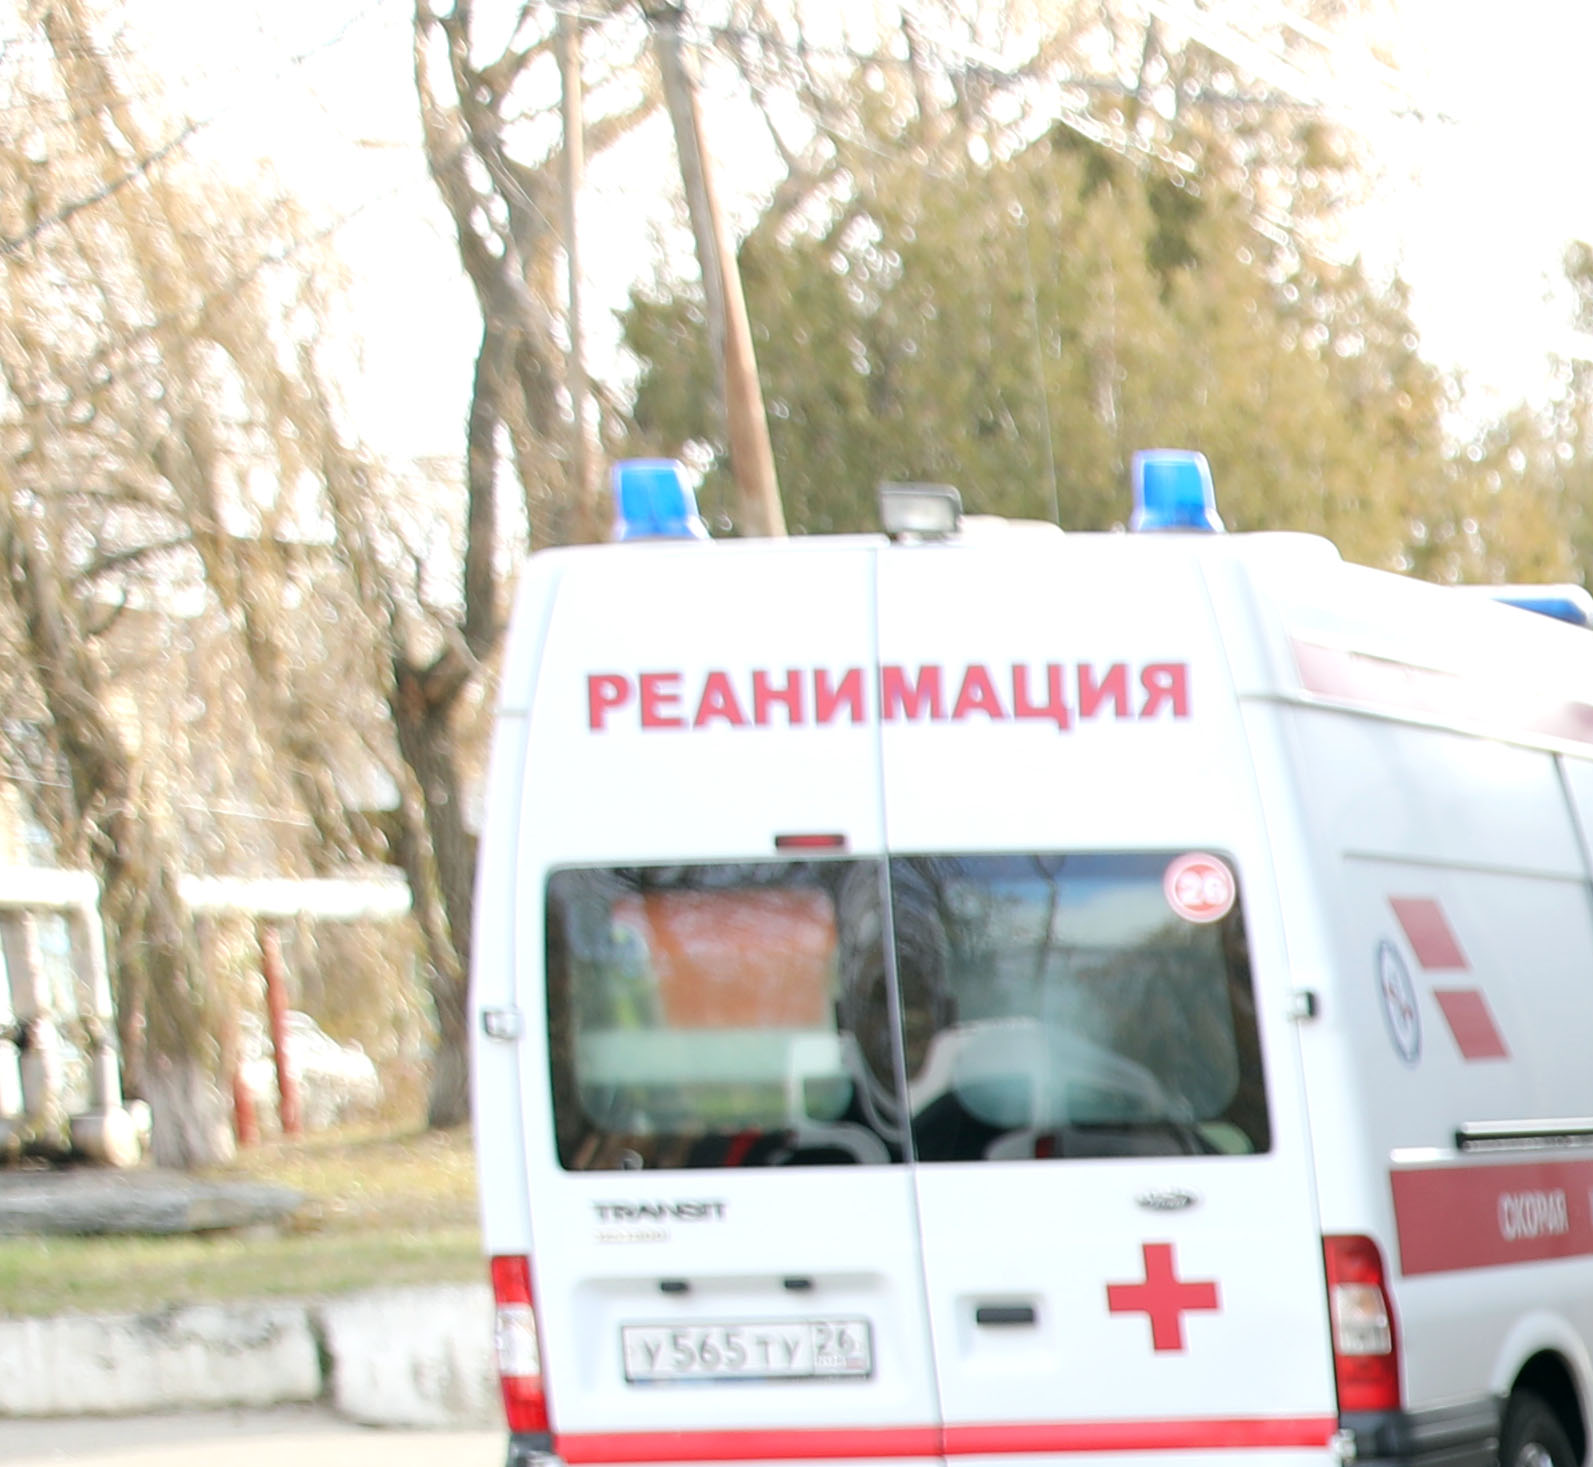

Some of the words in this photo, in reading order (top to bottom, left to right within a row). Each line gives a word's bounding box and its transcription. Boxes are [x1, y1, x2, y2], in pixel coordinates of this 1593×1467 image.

[586, 662, 1190, 731] РЕАНИМАЦИЯ
[594, 1202, 728, 1221] TRANSIT
[815, 1323, 857, 1353] 26
